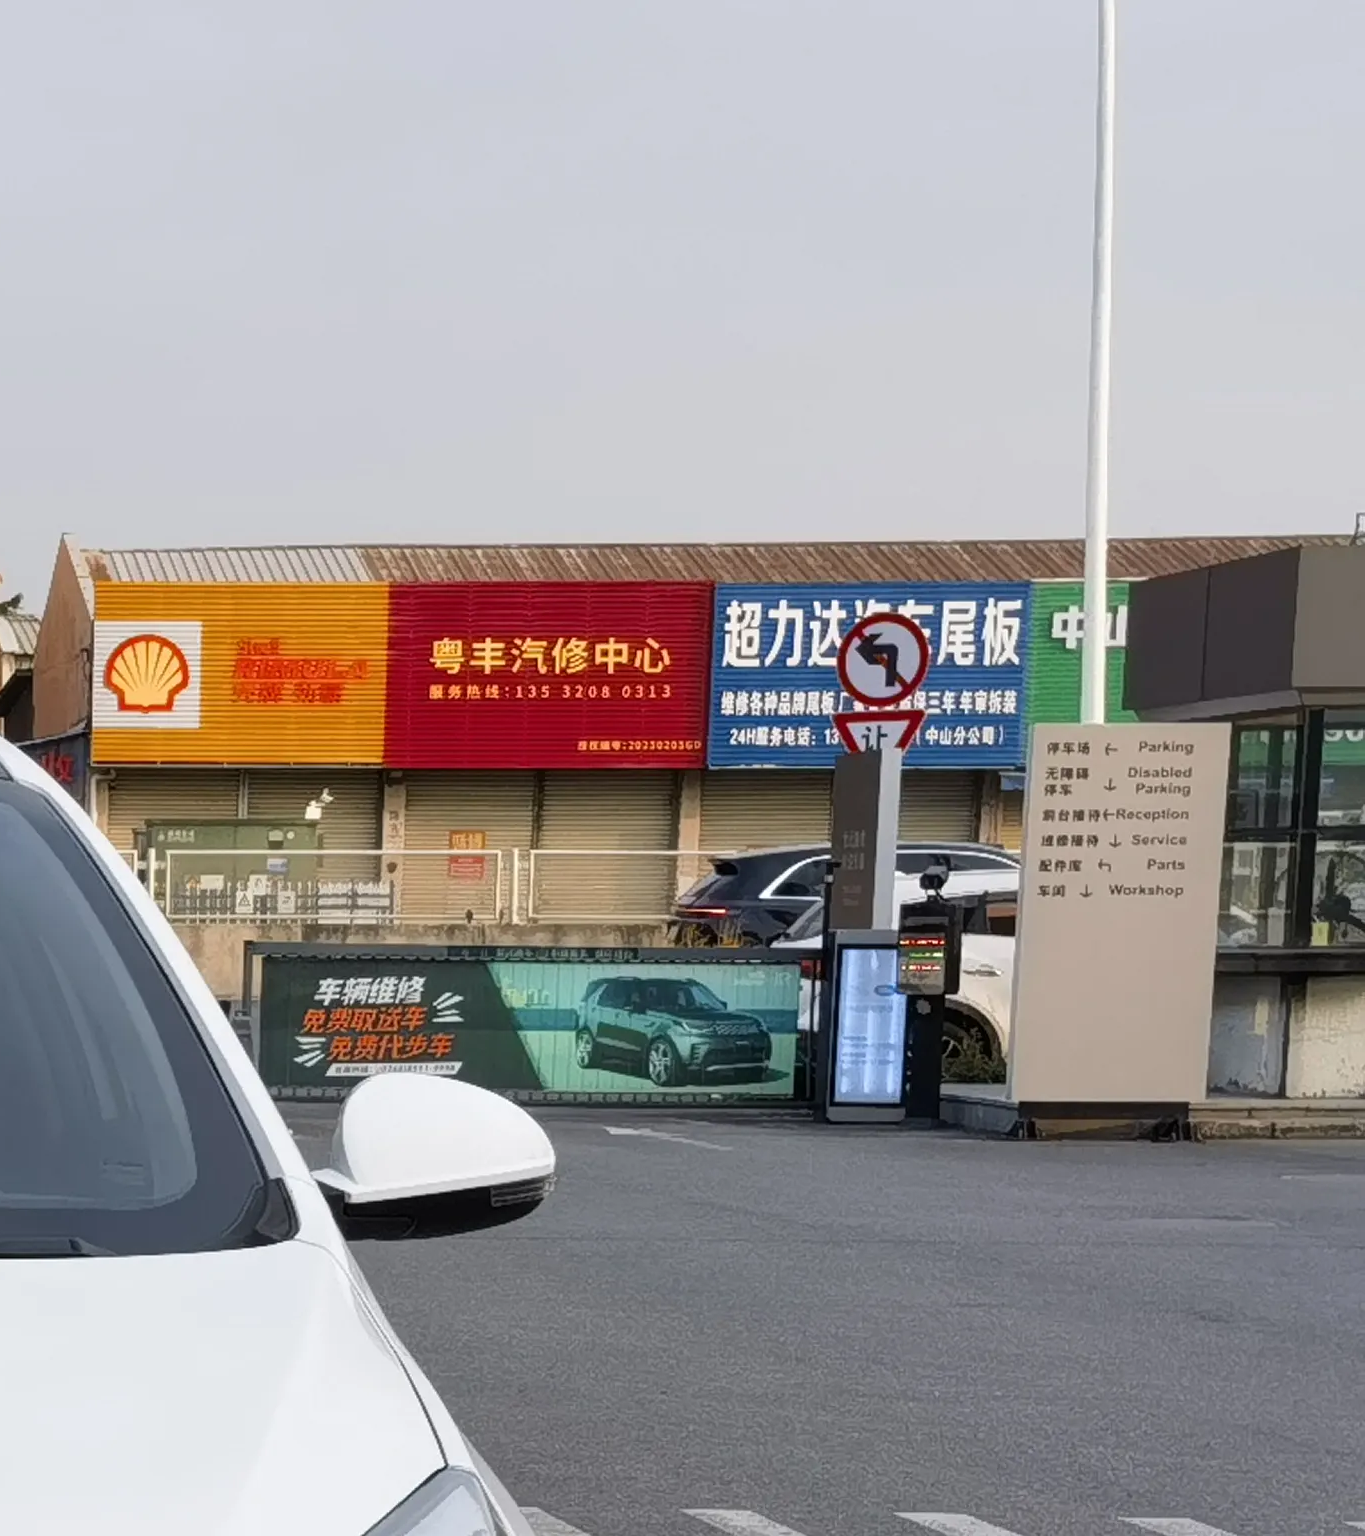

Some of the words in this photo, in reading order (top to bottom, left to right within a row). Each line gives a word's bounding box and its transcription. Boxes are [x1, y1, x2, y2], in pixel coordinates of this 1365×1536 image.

[722, 598, 1023, 667] 超力达尾板
[429, 637, 671, 674] 粤丰汽修中心
[562, 684, 610, 699] 3208
[621, 684, 671, 699] 0313
[1046, 741, 1091, 756] 停车场
[1138, 741, 1194, 755] Parking
[1127, 766, 1193, 778] Disabled
[1135, 783, 1192, 797] Parking
[1116, 808, 1190, 823] Reception
[1131, 834, 1188, 846] Service
[1147, 858, 1186, 871] Parts
[1108, 884, 1184, 899] Workshop
[314, 976, 427, 1006] 车辆维修
[300, 1006, 428, 1034] 免费取送车
[326, 1032, 456, 1061] 免费代步车
